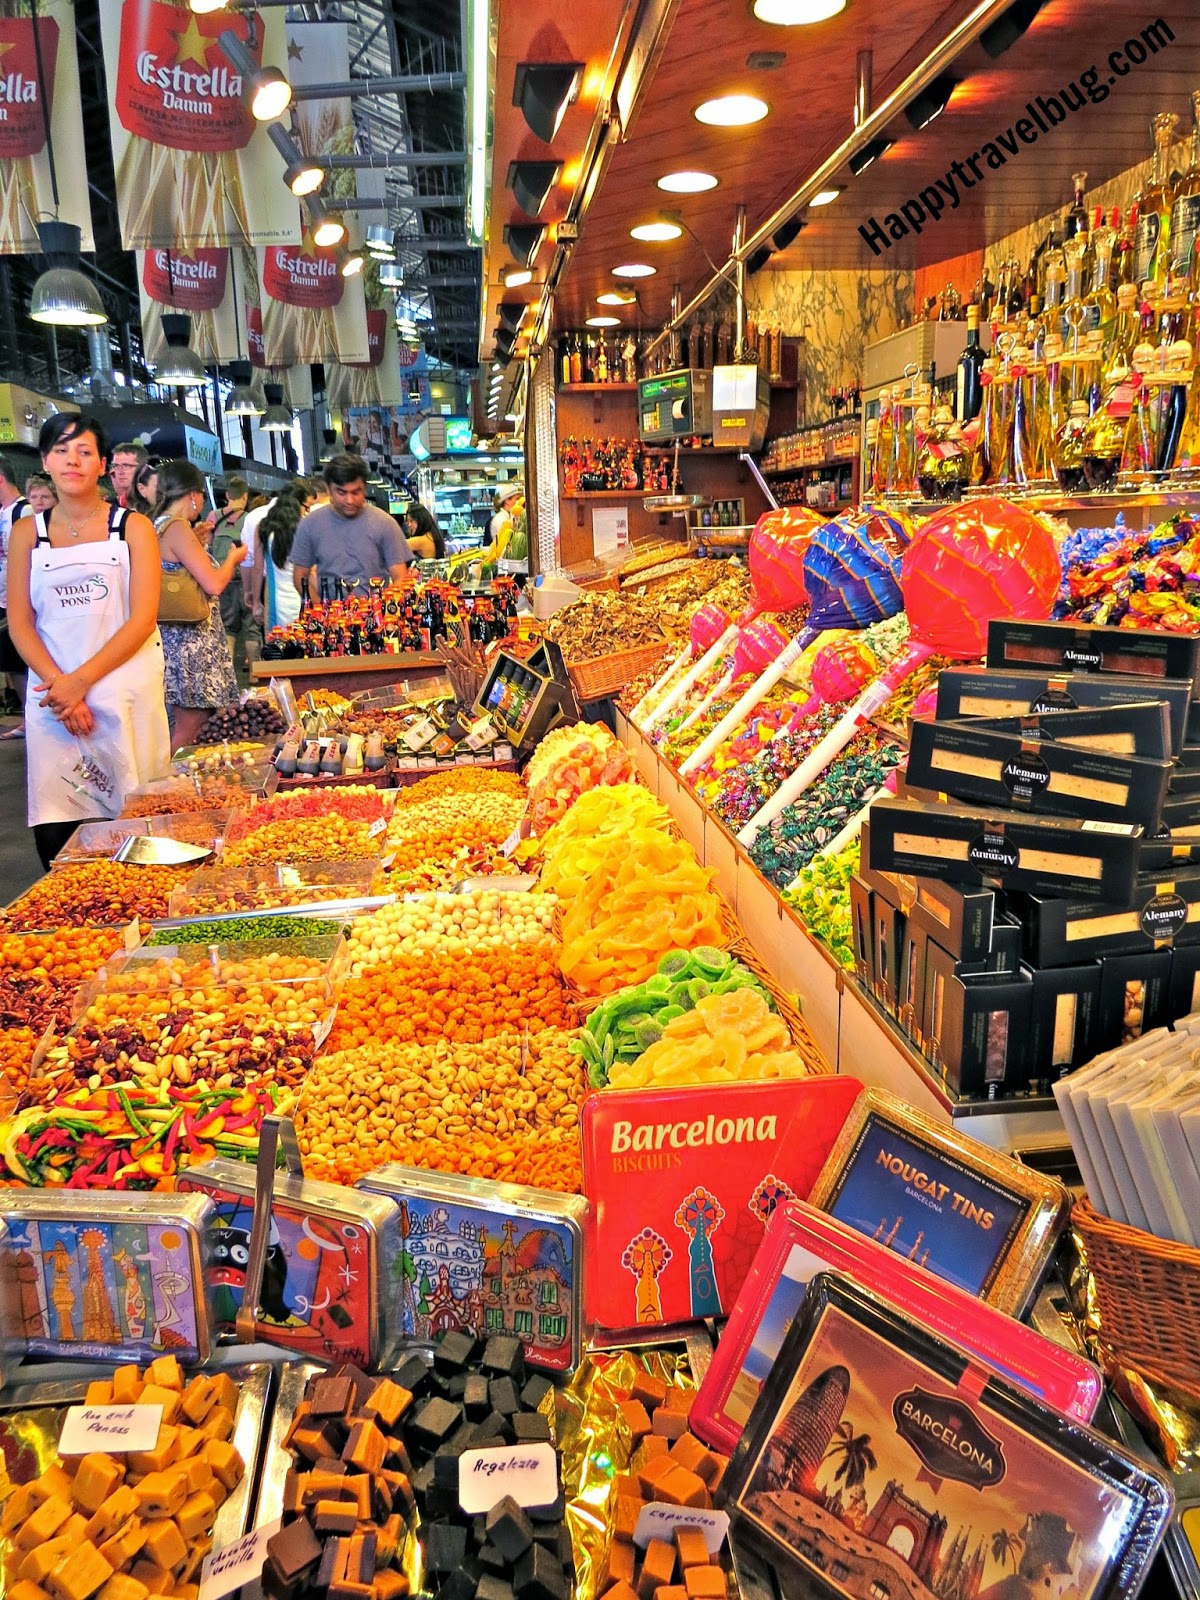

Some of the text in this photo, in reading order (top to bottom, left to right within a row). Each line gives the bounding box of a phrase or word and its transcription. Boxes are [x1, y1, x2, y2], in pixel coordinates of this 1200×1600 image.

[136, 50, 242, 97] Estrella
[0, 73, 37, 103] ella
[162, 90, 213, 115] Damm
[155, 249, 217, 279] Estrella
[275, 250, 337, 277] Estrella
[171, 274, 199, 289] Damm
[290, 273, 319, 287] Damm
[54, 584, 93, 596] VIDAL
[60, 595, 91, 608] PONS
[1063, 650, 1100, 664] Alemany
[1004, 764, 1048, 783] Alemany
[970, 848, 1017, 865] Alemany
[1143, 908, 1186, 922] Alemany
[610, 1114, 777, 1153] Barcelona
[612, 1152, 682, 1174] BISCUITS
[876, 1148, 995, 1230] NOUGAT TINS
[904, 1186, 943, 1214] BARCELONA
[902, 1401, 993, 1475] BARCELONA
